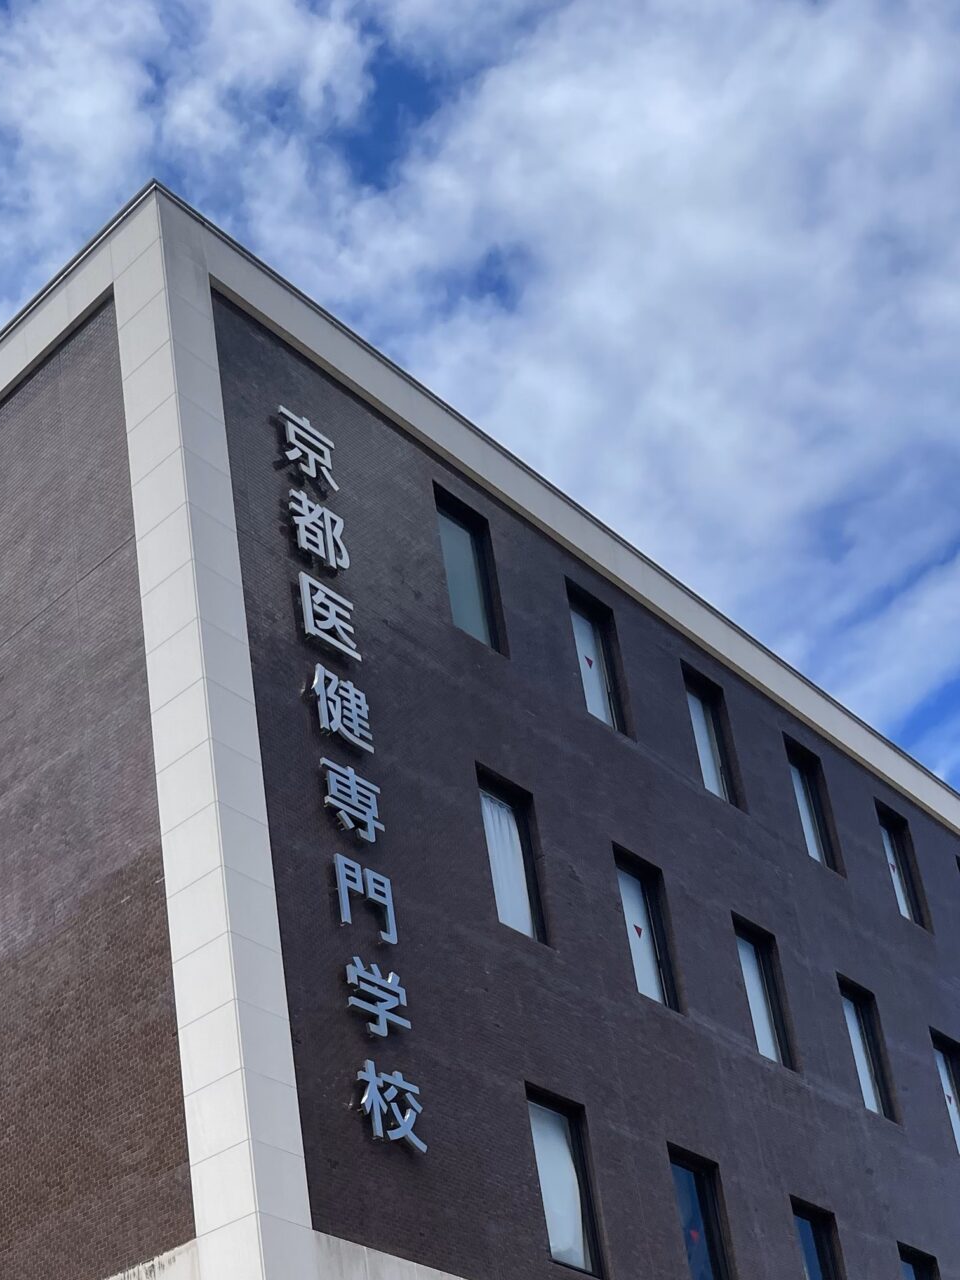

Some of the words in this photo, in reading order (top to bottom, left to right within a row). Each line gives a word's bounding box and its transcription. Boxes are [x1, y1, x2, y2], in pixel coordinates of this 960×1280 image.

[278, 405, 428, 1154] 京都医健専門学校
